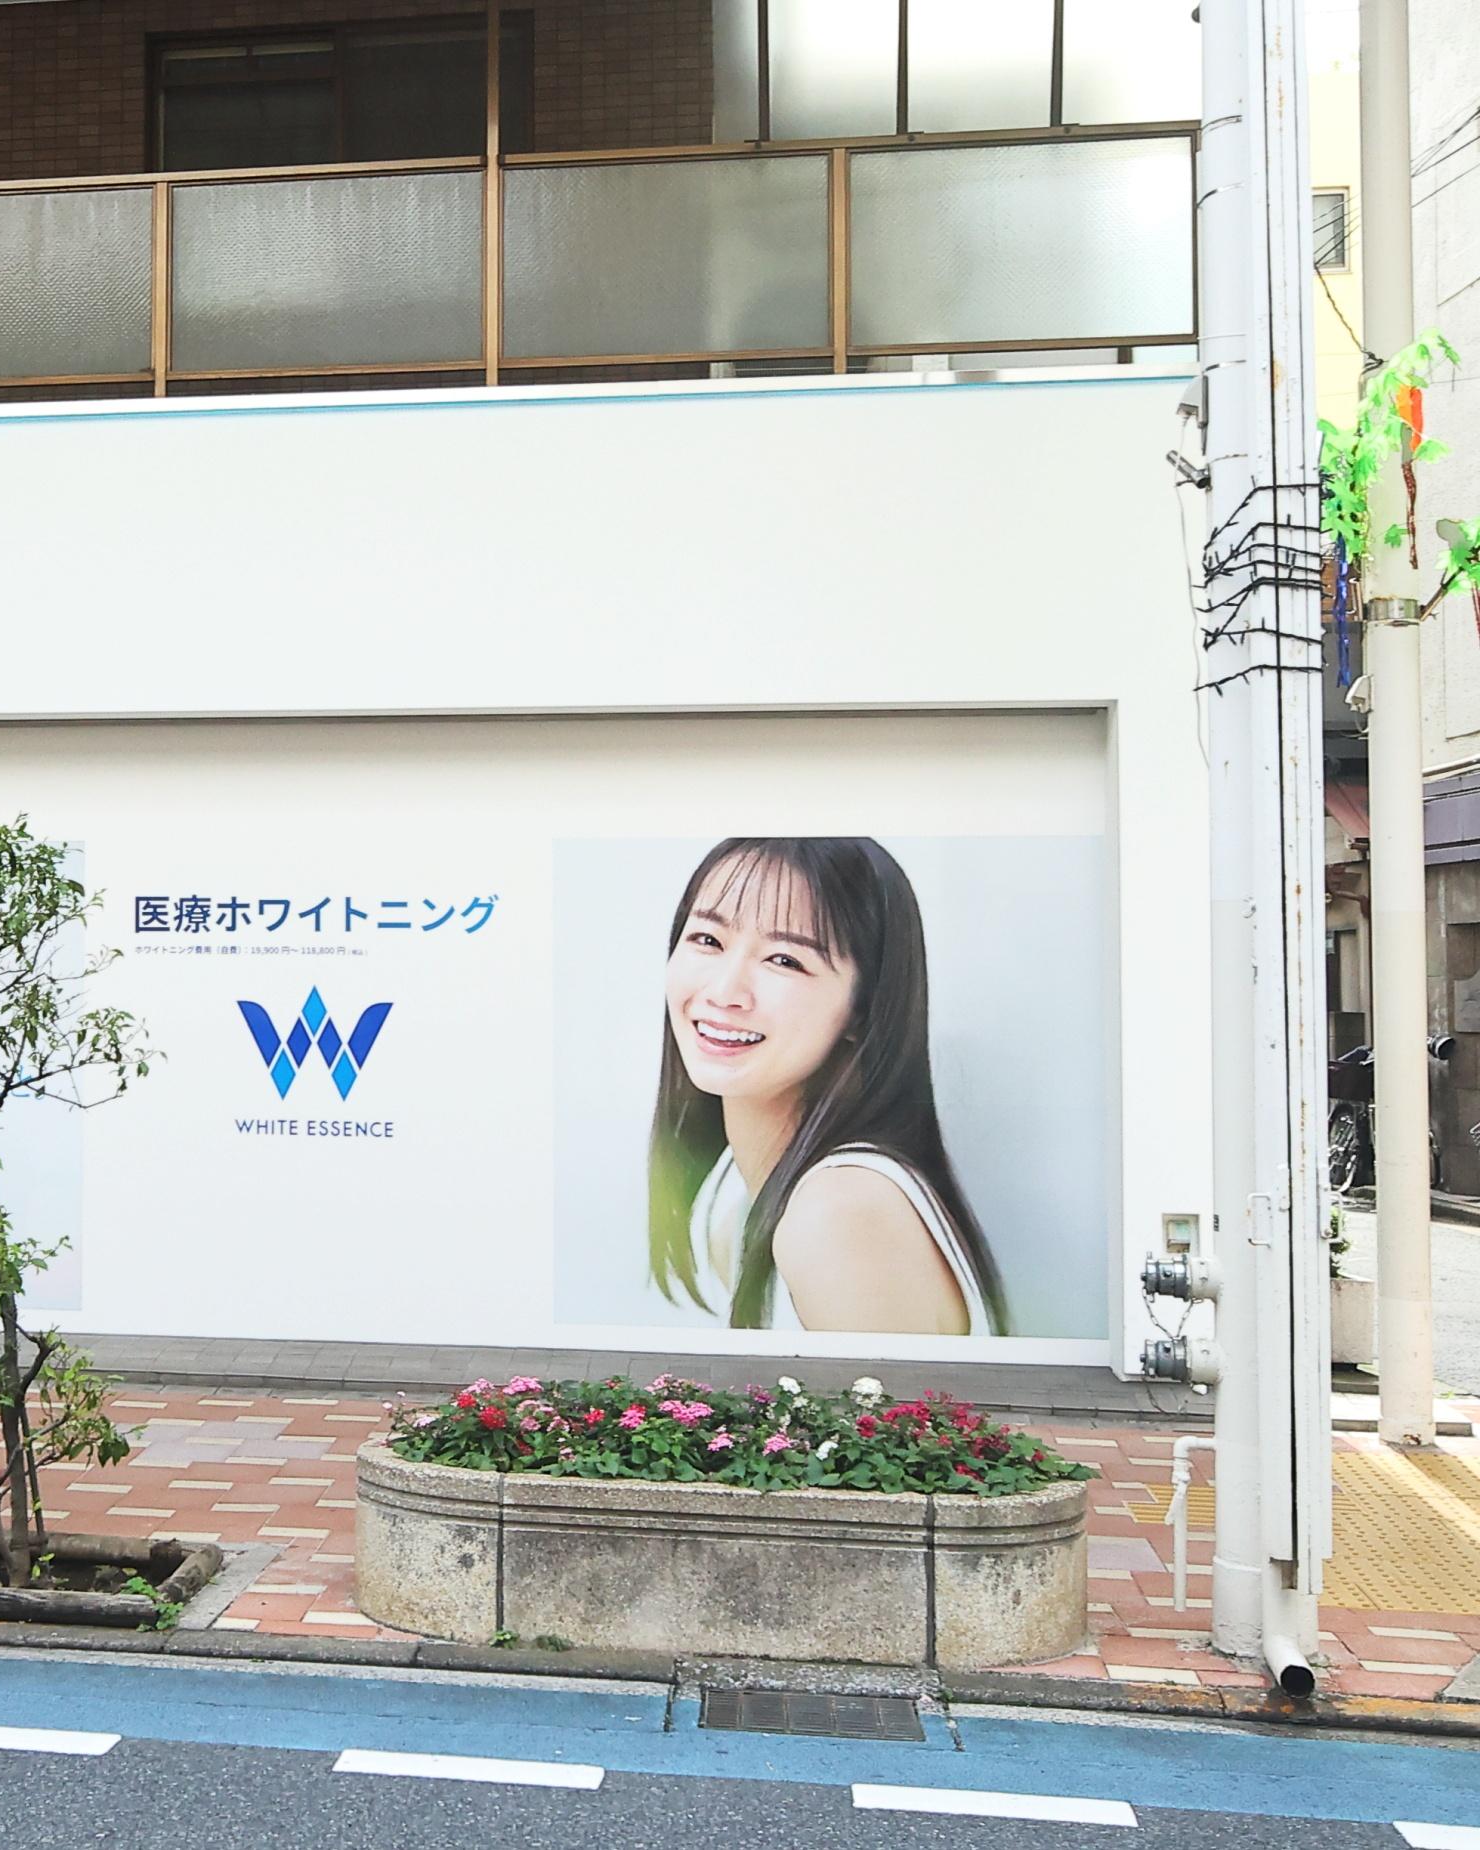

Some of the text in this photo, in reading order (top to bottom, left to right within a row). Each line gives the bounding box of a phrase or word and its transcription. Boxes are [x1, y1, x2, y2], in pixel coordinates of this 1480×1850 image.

[134, 893, 500, 935] 医療ホワイトニング
[234, 1118, 395, 1139] WHITE ESSENCE
